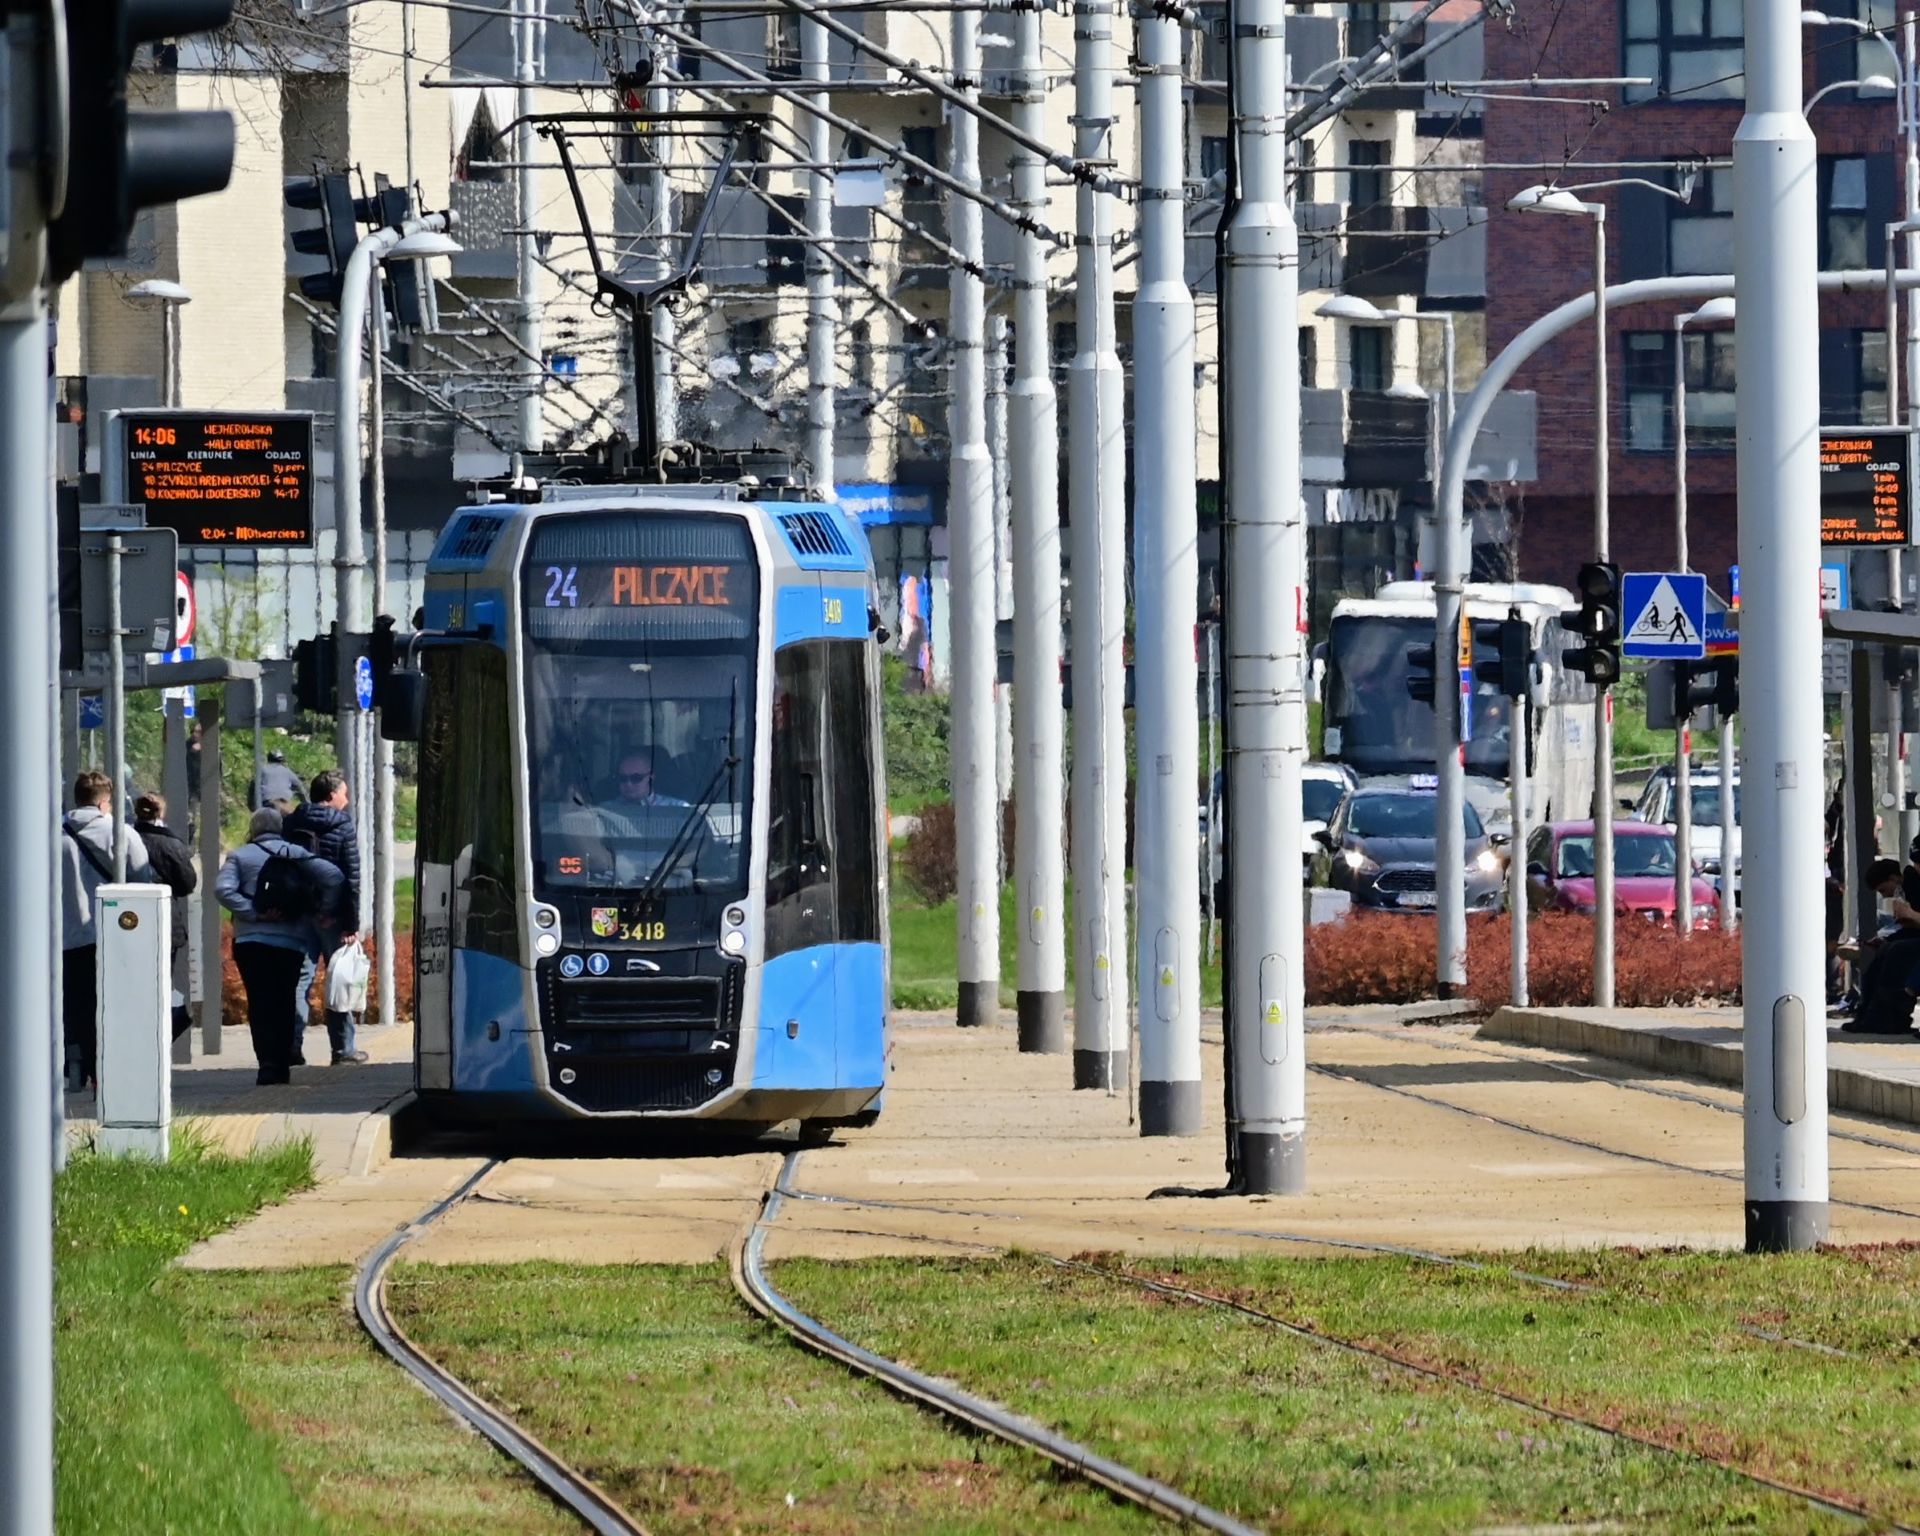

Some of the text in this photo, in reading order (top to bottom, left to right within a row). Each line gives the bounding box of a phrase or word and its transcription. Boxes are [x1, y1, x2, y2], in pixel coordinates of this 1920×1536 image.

[135, 427, 176, 446] 14:06
[203, 424, 273, 436] WEJHEROWSKA
[130, 450, 302, 460] LINIA KIERUNEK ODJAZD
[141, 462, 154, 472] 24
[156, 462, 203, 472] PILCZYCE
[1866, 462, 1900, 471] ODJAZD
[545, 565, 730, 607] 24 PILCZYCE
[823, 597, 842, 624] 3418
[618, 921, 666, 941] 3418
